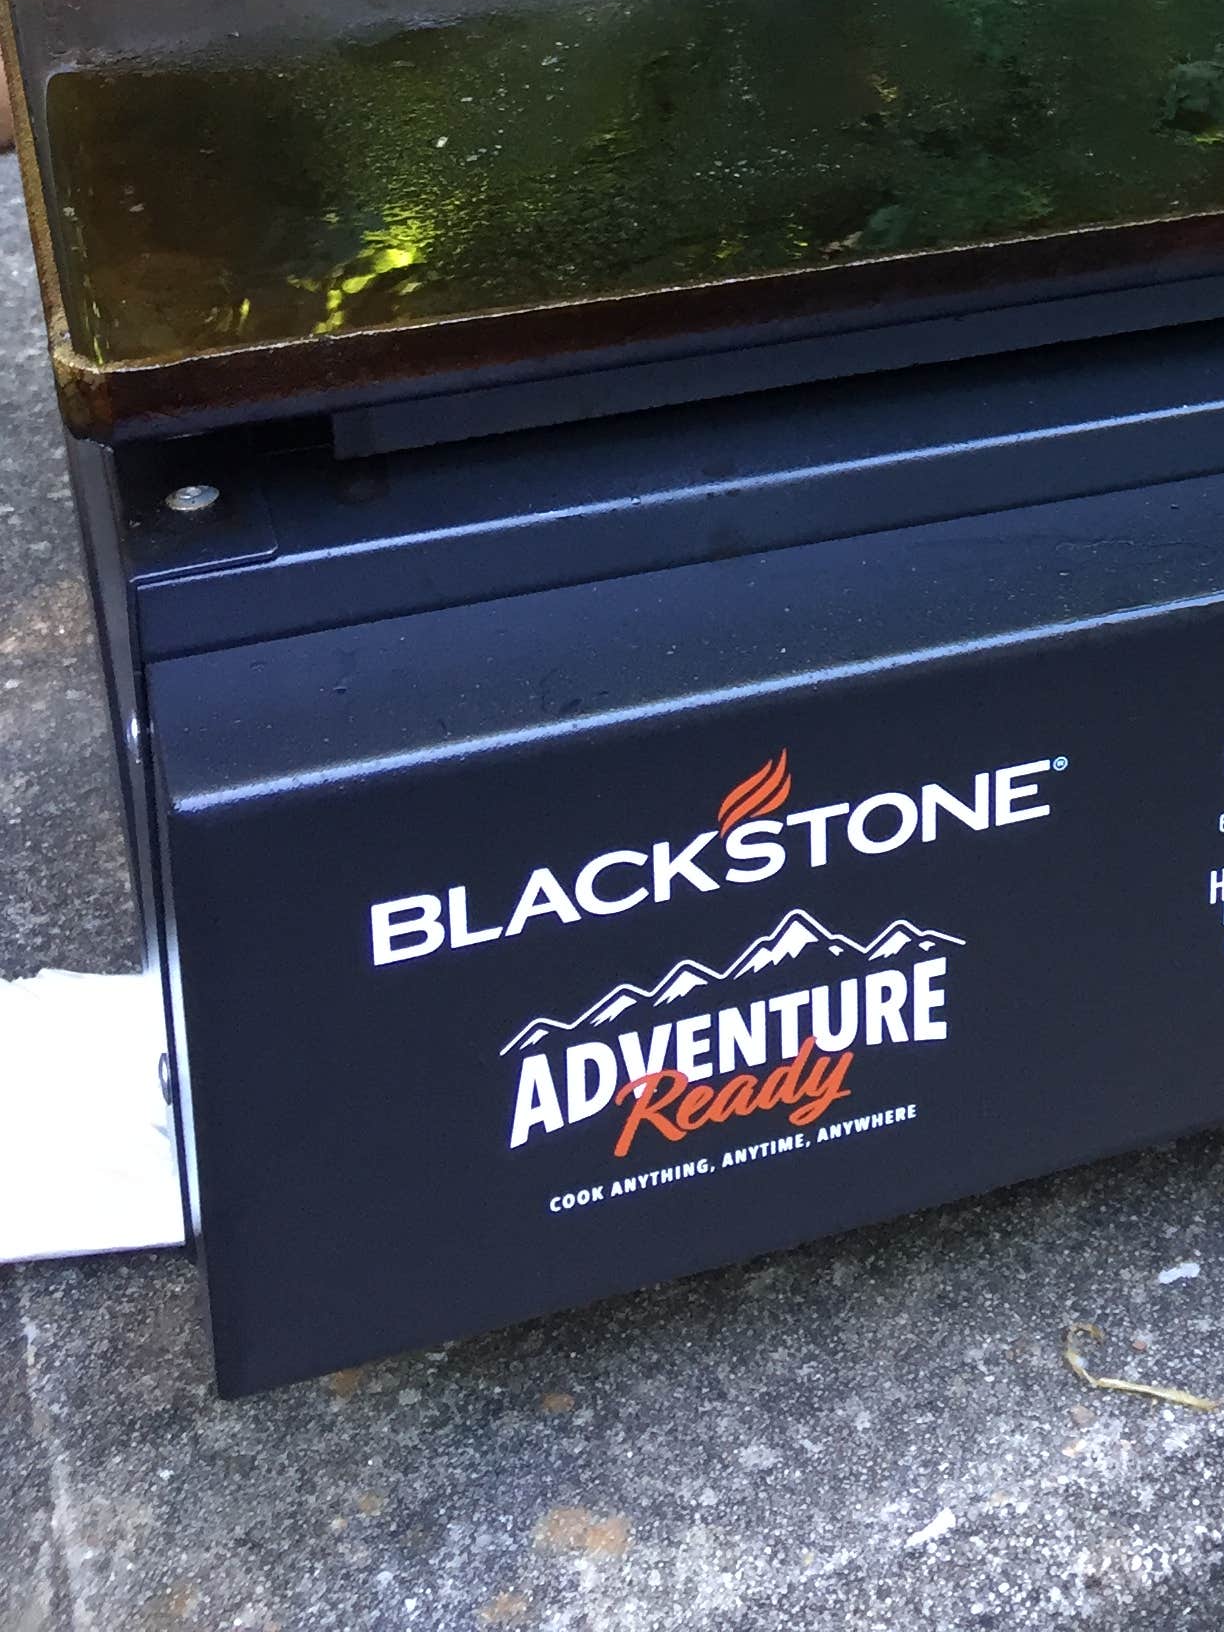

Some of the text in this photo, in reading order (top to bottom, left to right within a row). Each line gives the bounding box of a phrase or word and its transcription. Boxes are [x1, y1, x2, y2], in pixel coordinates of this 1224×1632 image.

[510, 957, 946, 1149] ADVENTURE
[614, 1035, 855, 1158] Ready
[549, 1103, 917, 1213] COOK ANYTHING, ANYTIME, ANYWHERE
